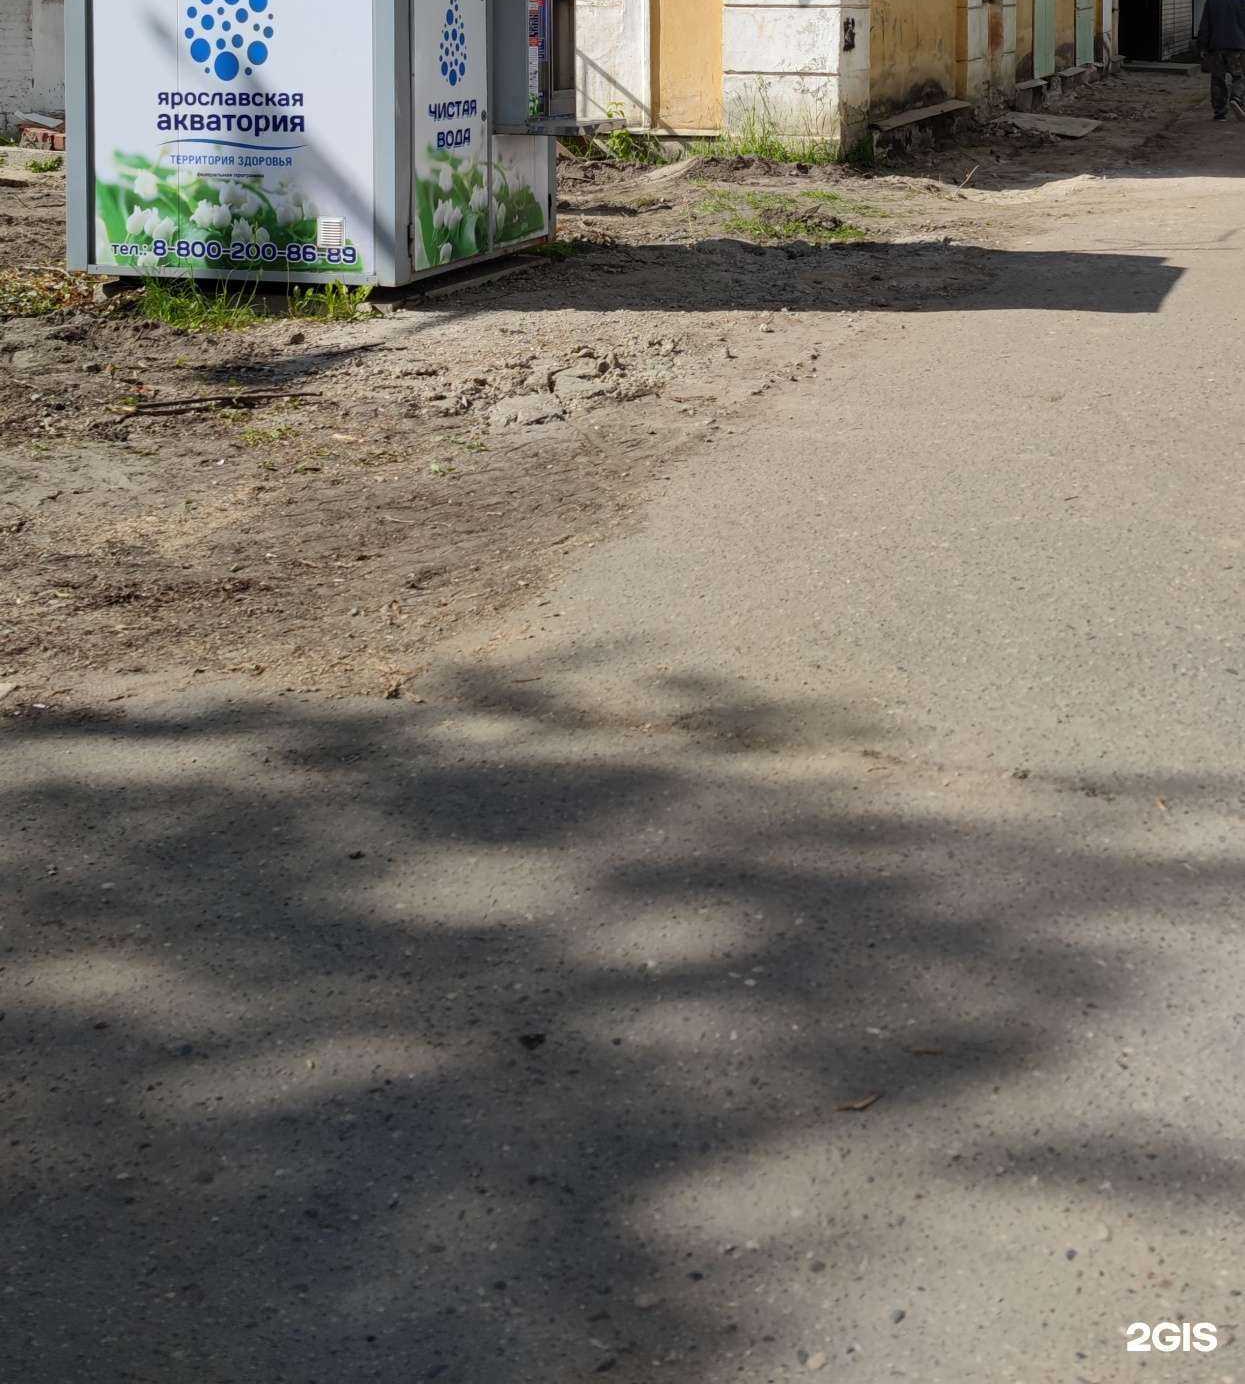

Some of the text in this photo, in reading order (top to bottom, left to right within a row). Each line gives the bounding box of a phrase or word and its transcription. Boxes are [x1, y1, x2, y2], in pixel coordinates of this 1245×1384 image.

[157, 91, 304, 109] ярославская
[428, 99, 477, 121] ЧИСТАЯ
[157, 113, 305, 136] акватория
[437, 128, 471, 148] ВОДА
[170, 155, 293, 167] ТЕРРИТОРИЯ ЗДОРОВЬЯ
[111, 239, 357, 264] тел.: 8-800-200-86-89
